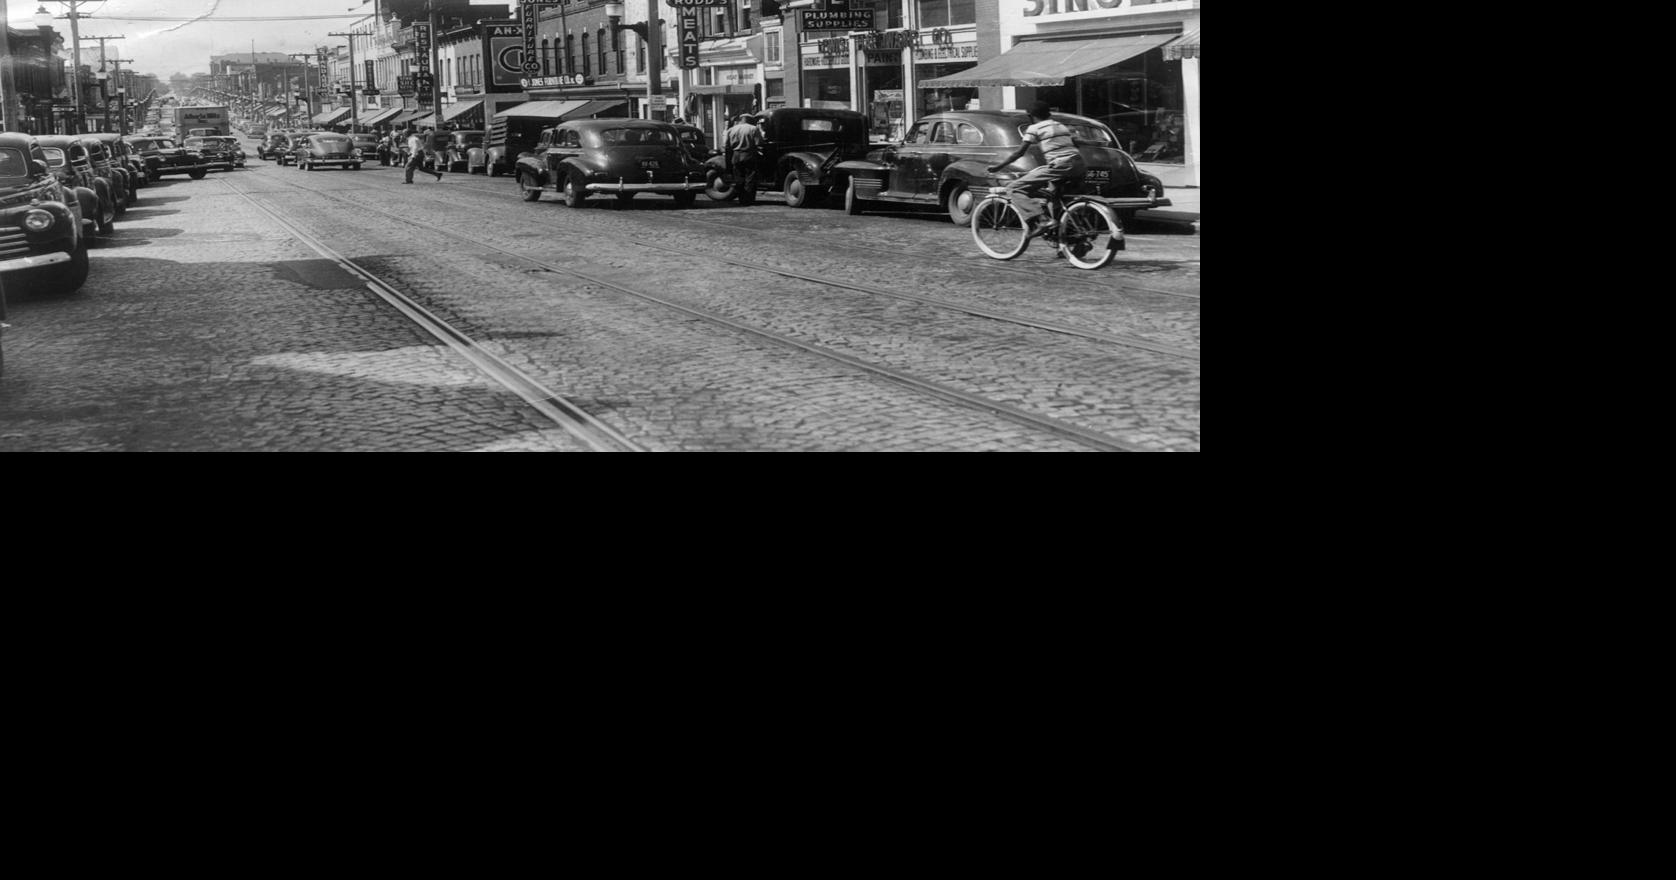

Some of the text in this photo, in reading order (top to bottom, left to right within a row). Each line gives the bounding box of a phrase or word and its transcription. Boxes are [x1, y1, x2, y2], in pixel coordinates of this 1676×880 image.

[804, 11, 871, 20] PLUMBING
[808, 20, 868, 28] SUPPLIES
[525, 5, 535, 62] FURNITURE
[682, 7, 698, 66] MEATS
[420, 26, 430, 91] RESTAURANT
[525, 62, 538, 70] CO
